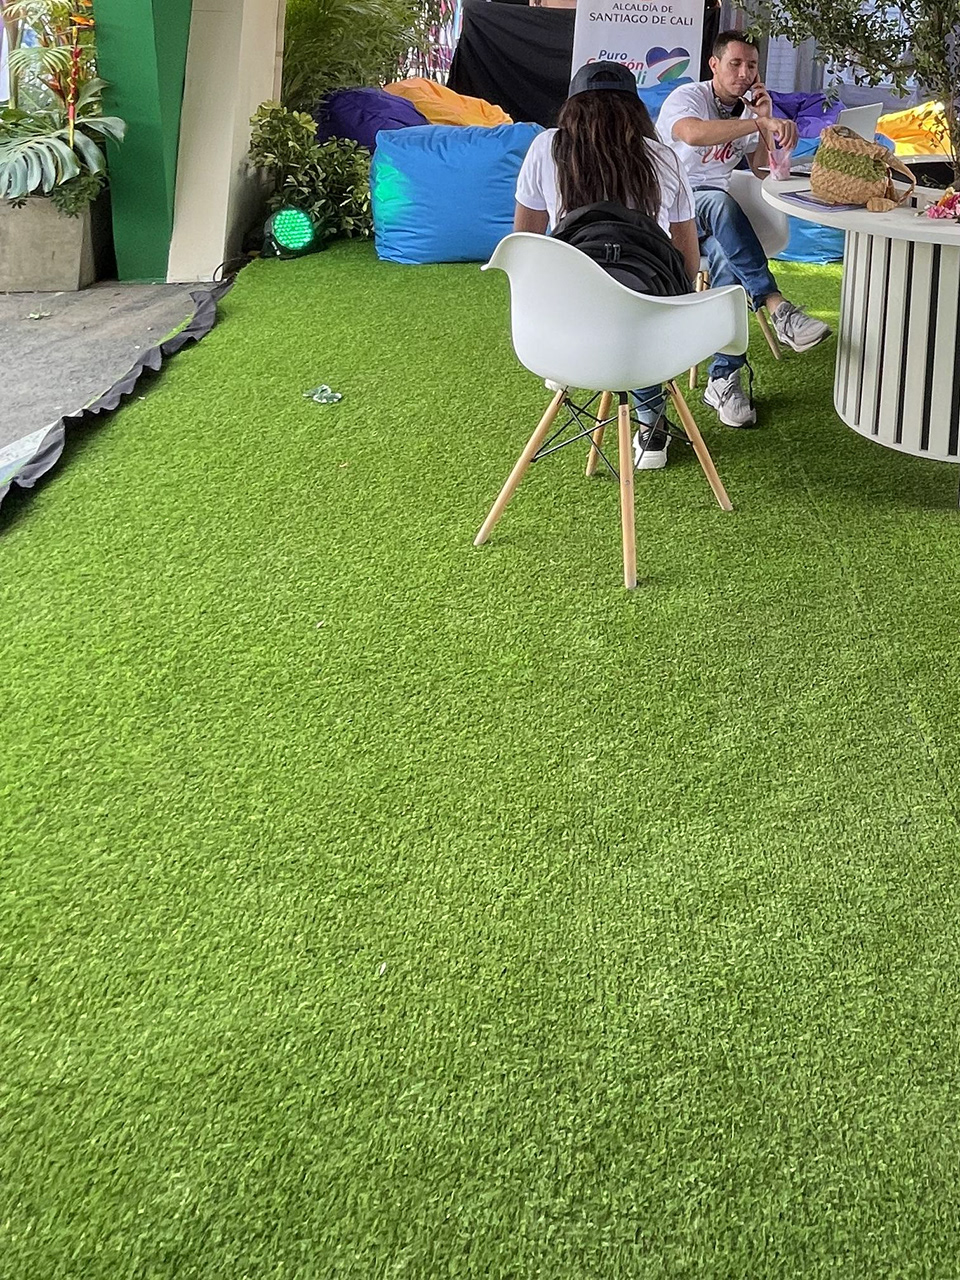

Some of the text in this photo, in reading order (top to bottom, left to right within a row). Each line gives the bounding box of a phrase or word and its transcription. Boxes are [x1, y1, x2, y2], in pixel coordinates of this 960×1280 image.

[612, 2, 673, 13] ALCALDÍA DE
[589, 12, 693, 26] SANTIAGO DE CALI
[598, 49, 628, 61] Puro
